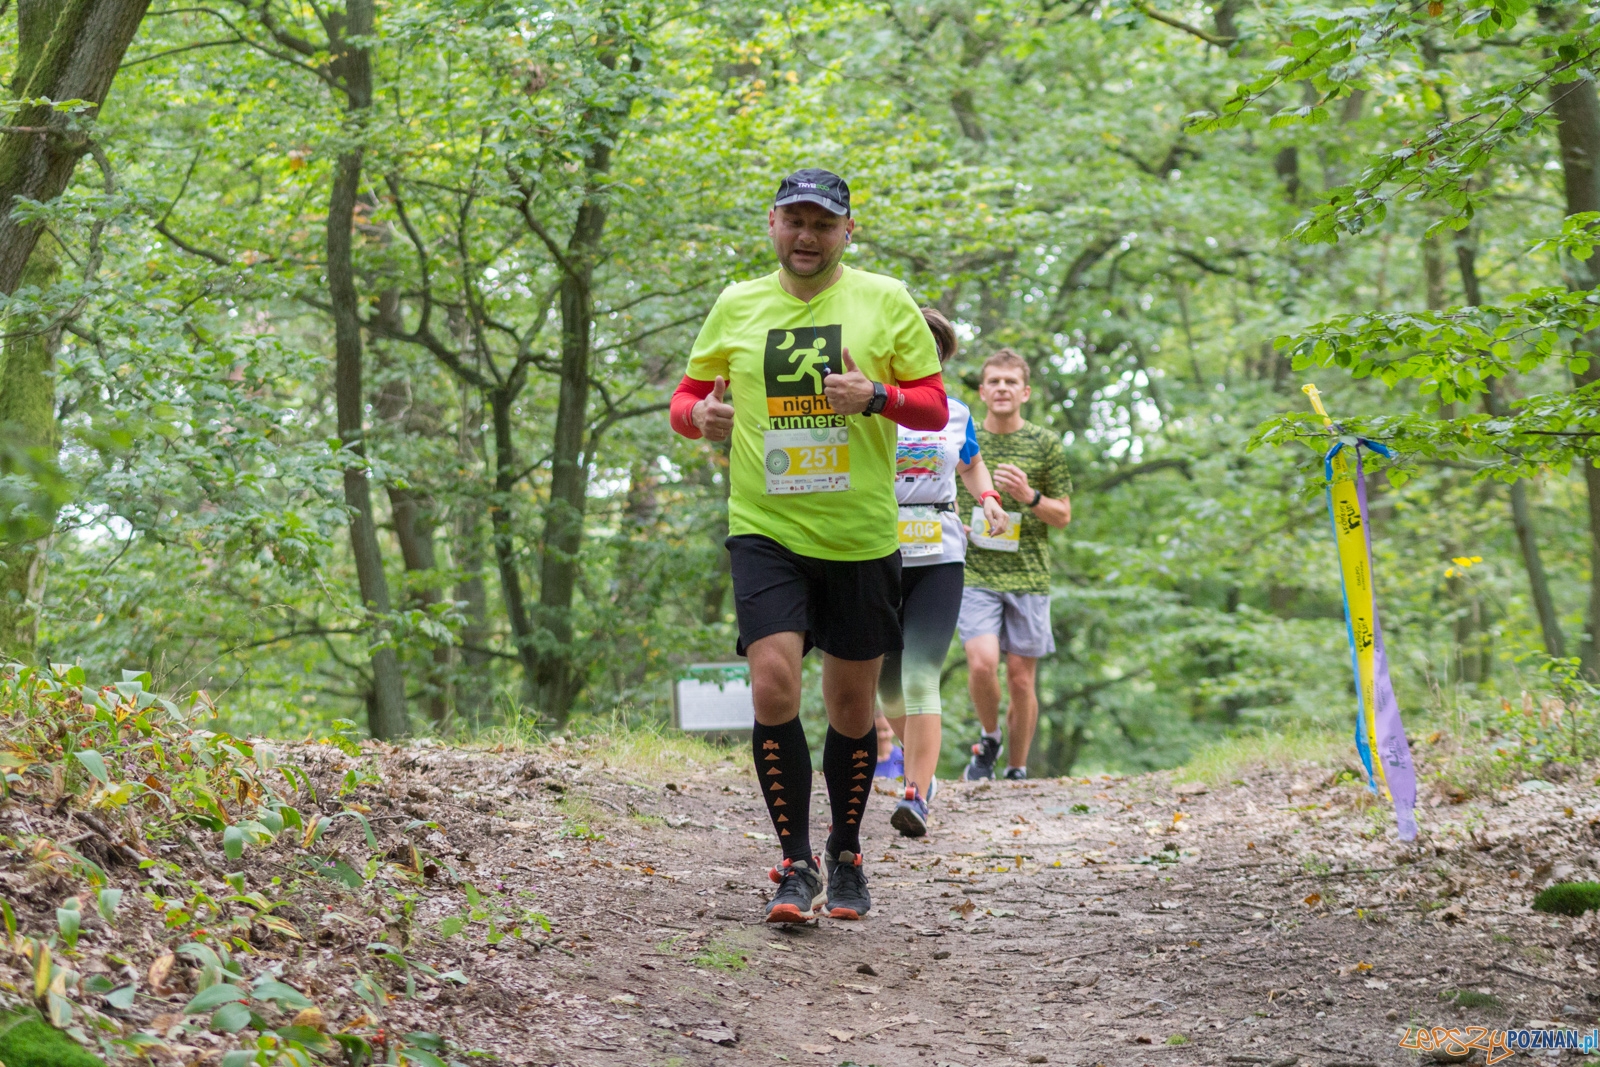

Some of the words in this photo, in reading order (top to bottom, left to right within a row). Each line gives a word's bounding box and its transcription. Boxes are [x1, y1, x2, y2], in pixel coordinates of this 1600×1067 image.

[783, 395, 831, 415] night
[770, 415, 844, 430] runners
[799, 447, 839, 468] 251
[903, 522, 935, 538] 406
